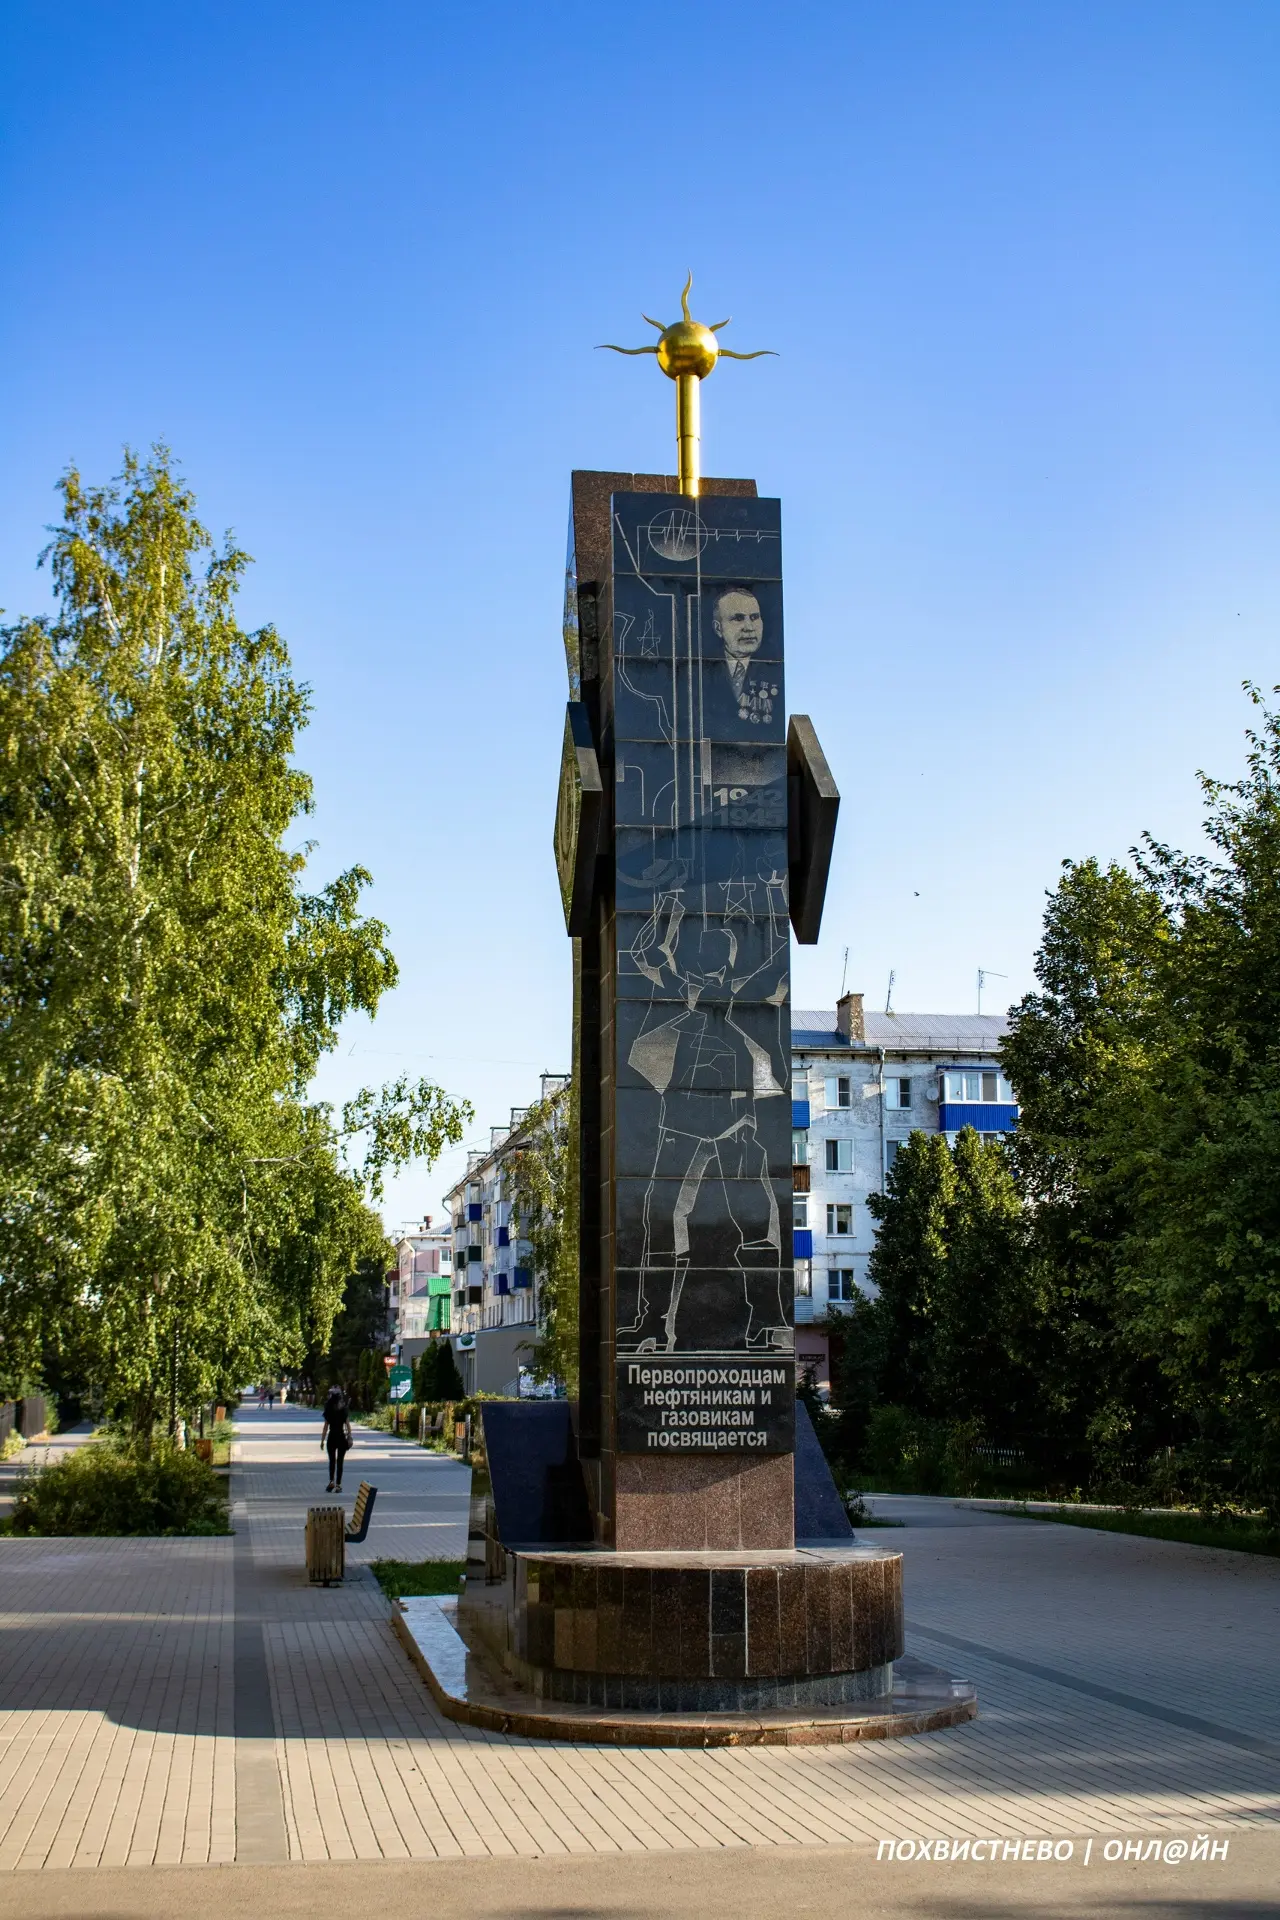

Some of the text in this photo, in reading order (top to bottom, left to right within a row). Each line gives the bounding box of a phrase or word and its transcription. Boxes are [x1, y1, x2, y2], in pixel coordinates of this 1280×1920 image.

[628, 1364, 786, 1388] Первопроходцам
[644, 1389, 771, 1410] нефтяникам и
[661, 1411, 753, 1426] газовикам
[647, 1431, 767, 1450] посвящается
